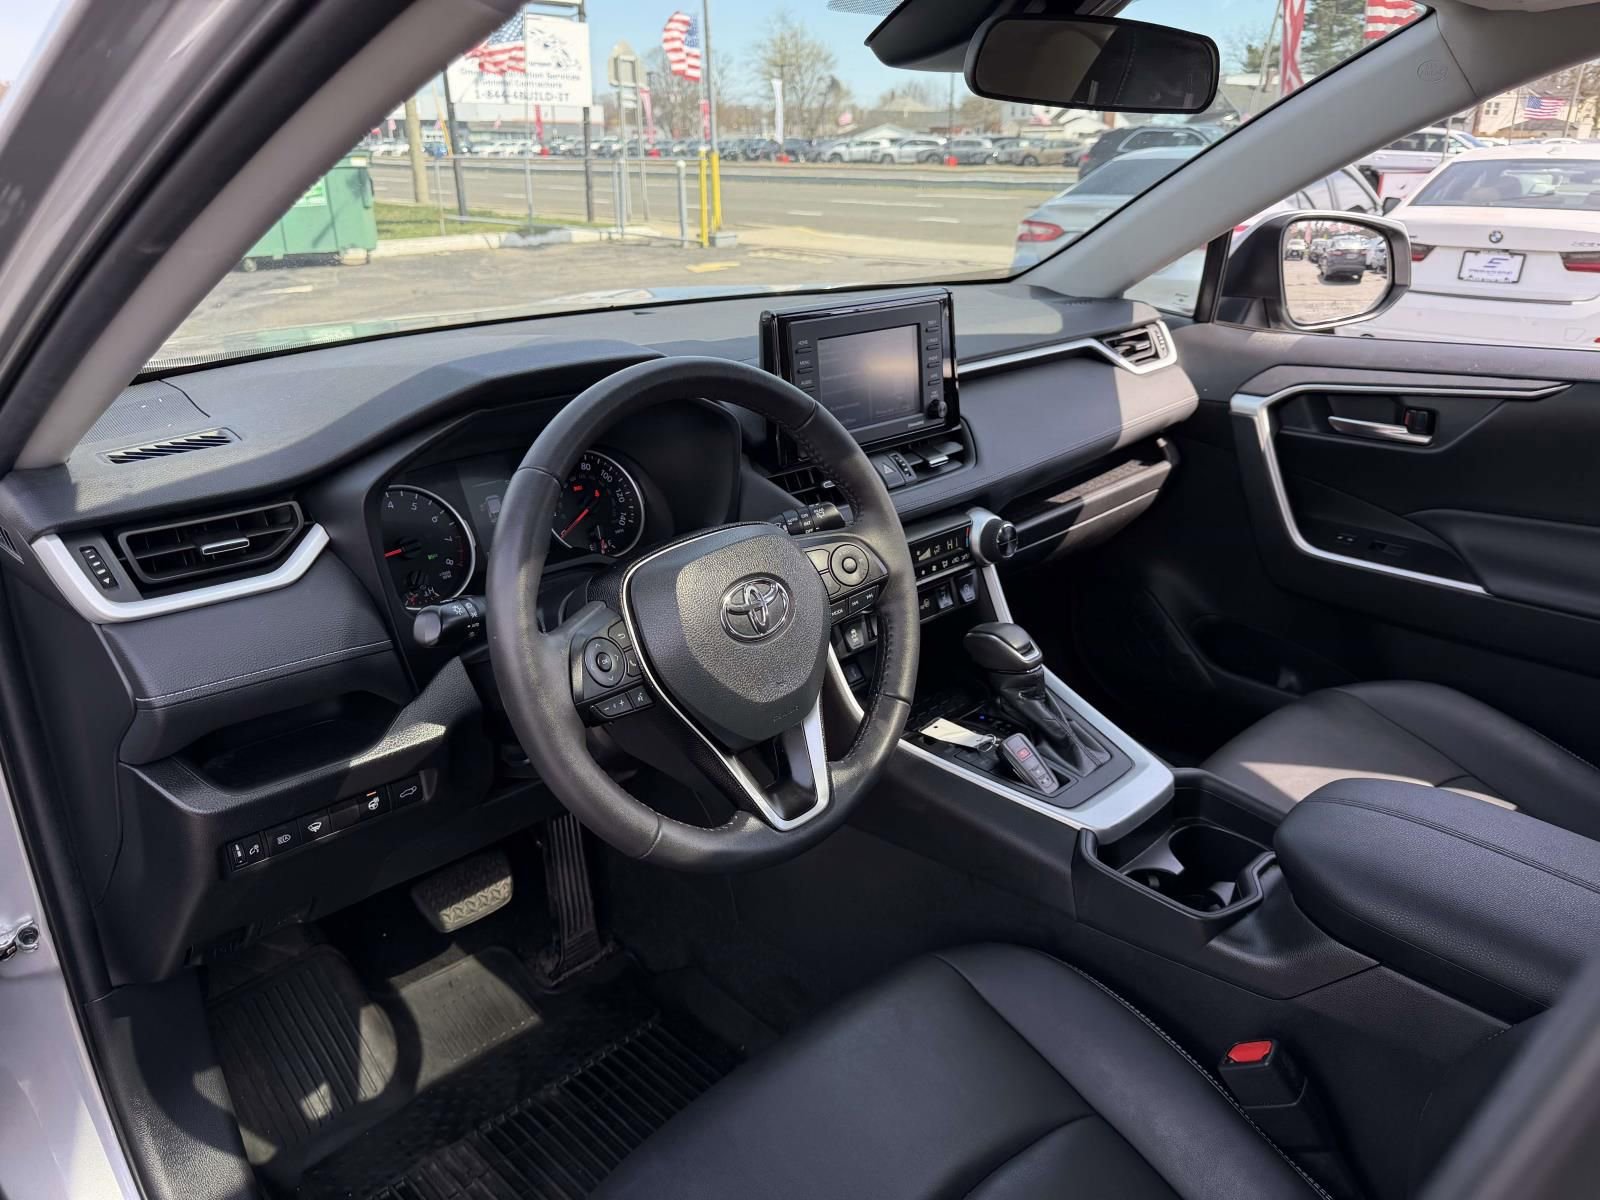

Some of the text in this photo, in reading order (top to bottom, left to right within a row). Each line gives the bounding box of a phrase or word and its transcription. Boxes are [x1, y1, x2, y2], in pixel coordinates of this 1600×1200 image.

[580, 462, 591, 471] 80
[600, 469, 613, 483] 100
[615, 488, 625, 504] 120
[387, 501, 394, 509] 4
[410, 502, 417, 511] 5
[431, 515, 438, 523] 6
[618, 512, 627, 526] 140
[946, 536, 958, 550] HI
